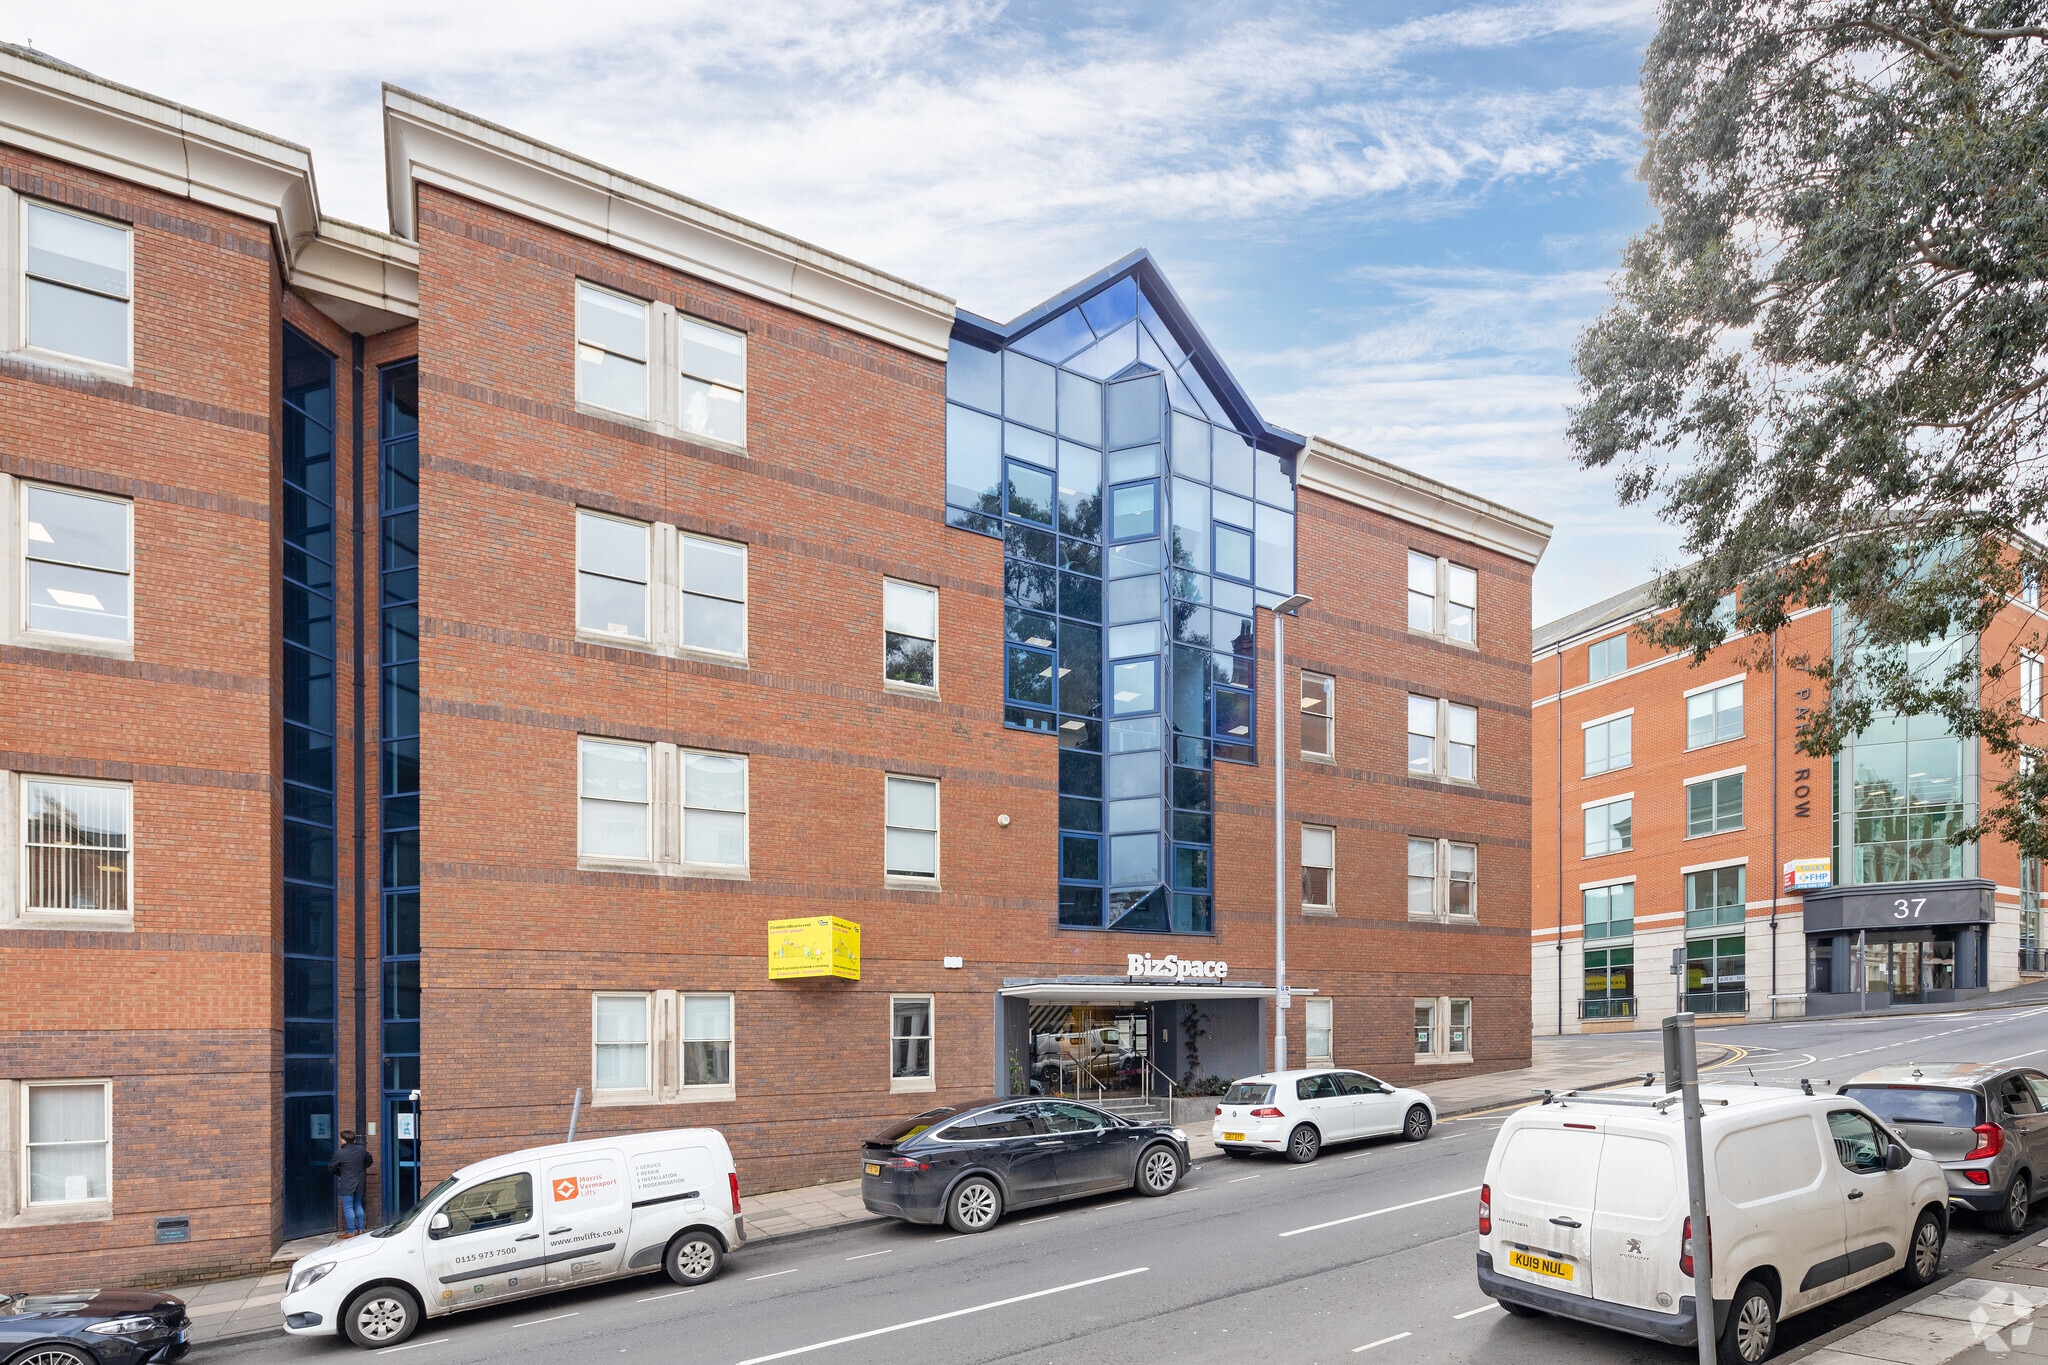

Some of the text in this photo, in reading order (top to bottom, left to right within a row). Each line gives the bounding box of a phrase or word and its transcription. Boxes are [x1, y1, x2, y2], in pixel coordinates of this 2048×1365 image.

[1794, 768, 1811, 818] ROW
[1894, 898, 1927, 919] 37
[1127, 952, 1228, 982] BizSpace
[579, 1174, 603, 1183] Morris
[580, 1179, 617, 1190] Vermaport
[642, 1173, 678, 1182] INSTALLATION
[643, 1178, 686, 1189] MODERNISATION
[550, 1227, 624, 1247] www.mvlifts.co.uk
[455, 1246, 517, 1264] 0115 973 7500
[1515, 1253, 1565, 1276] KU19 NUL
